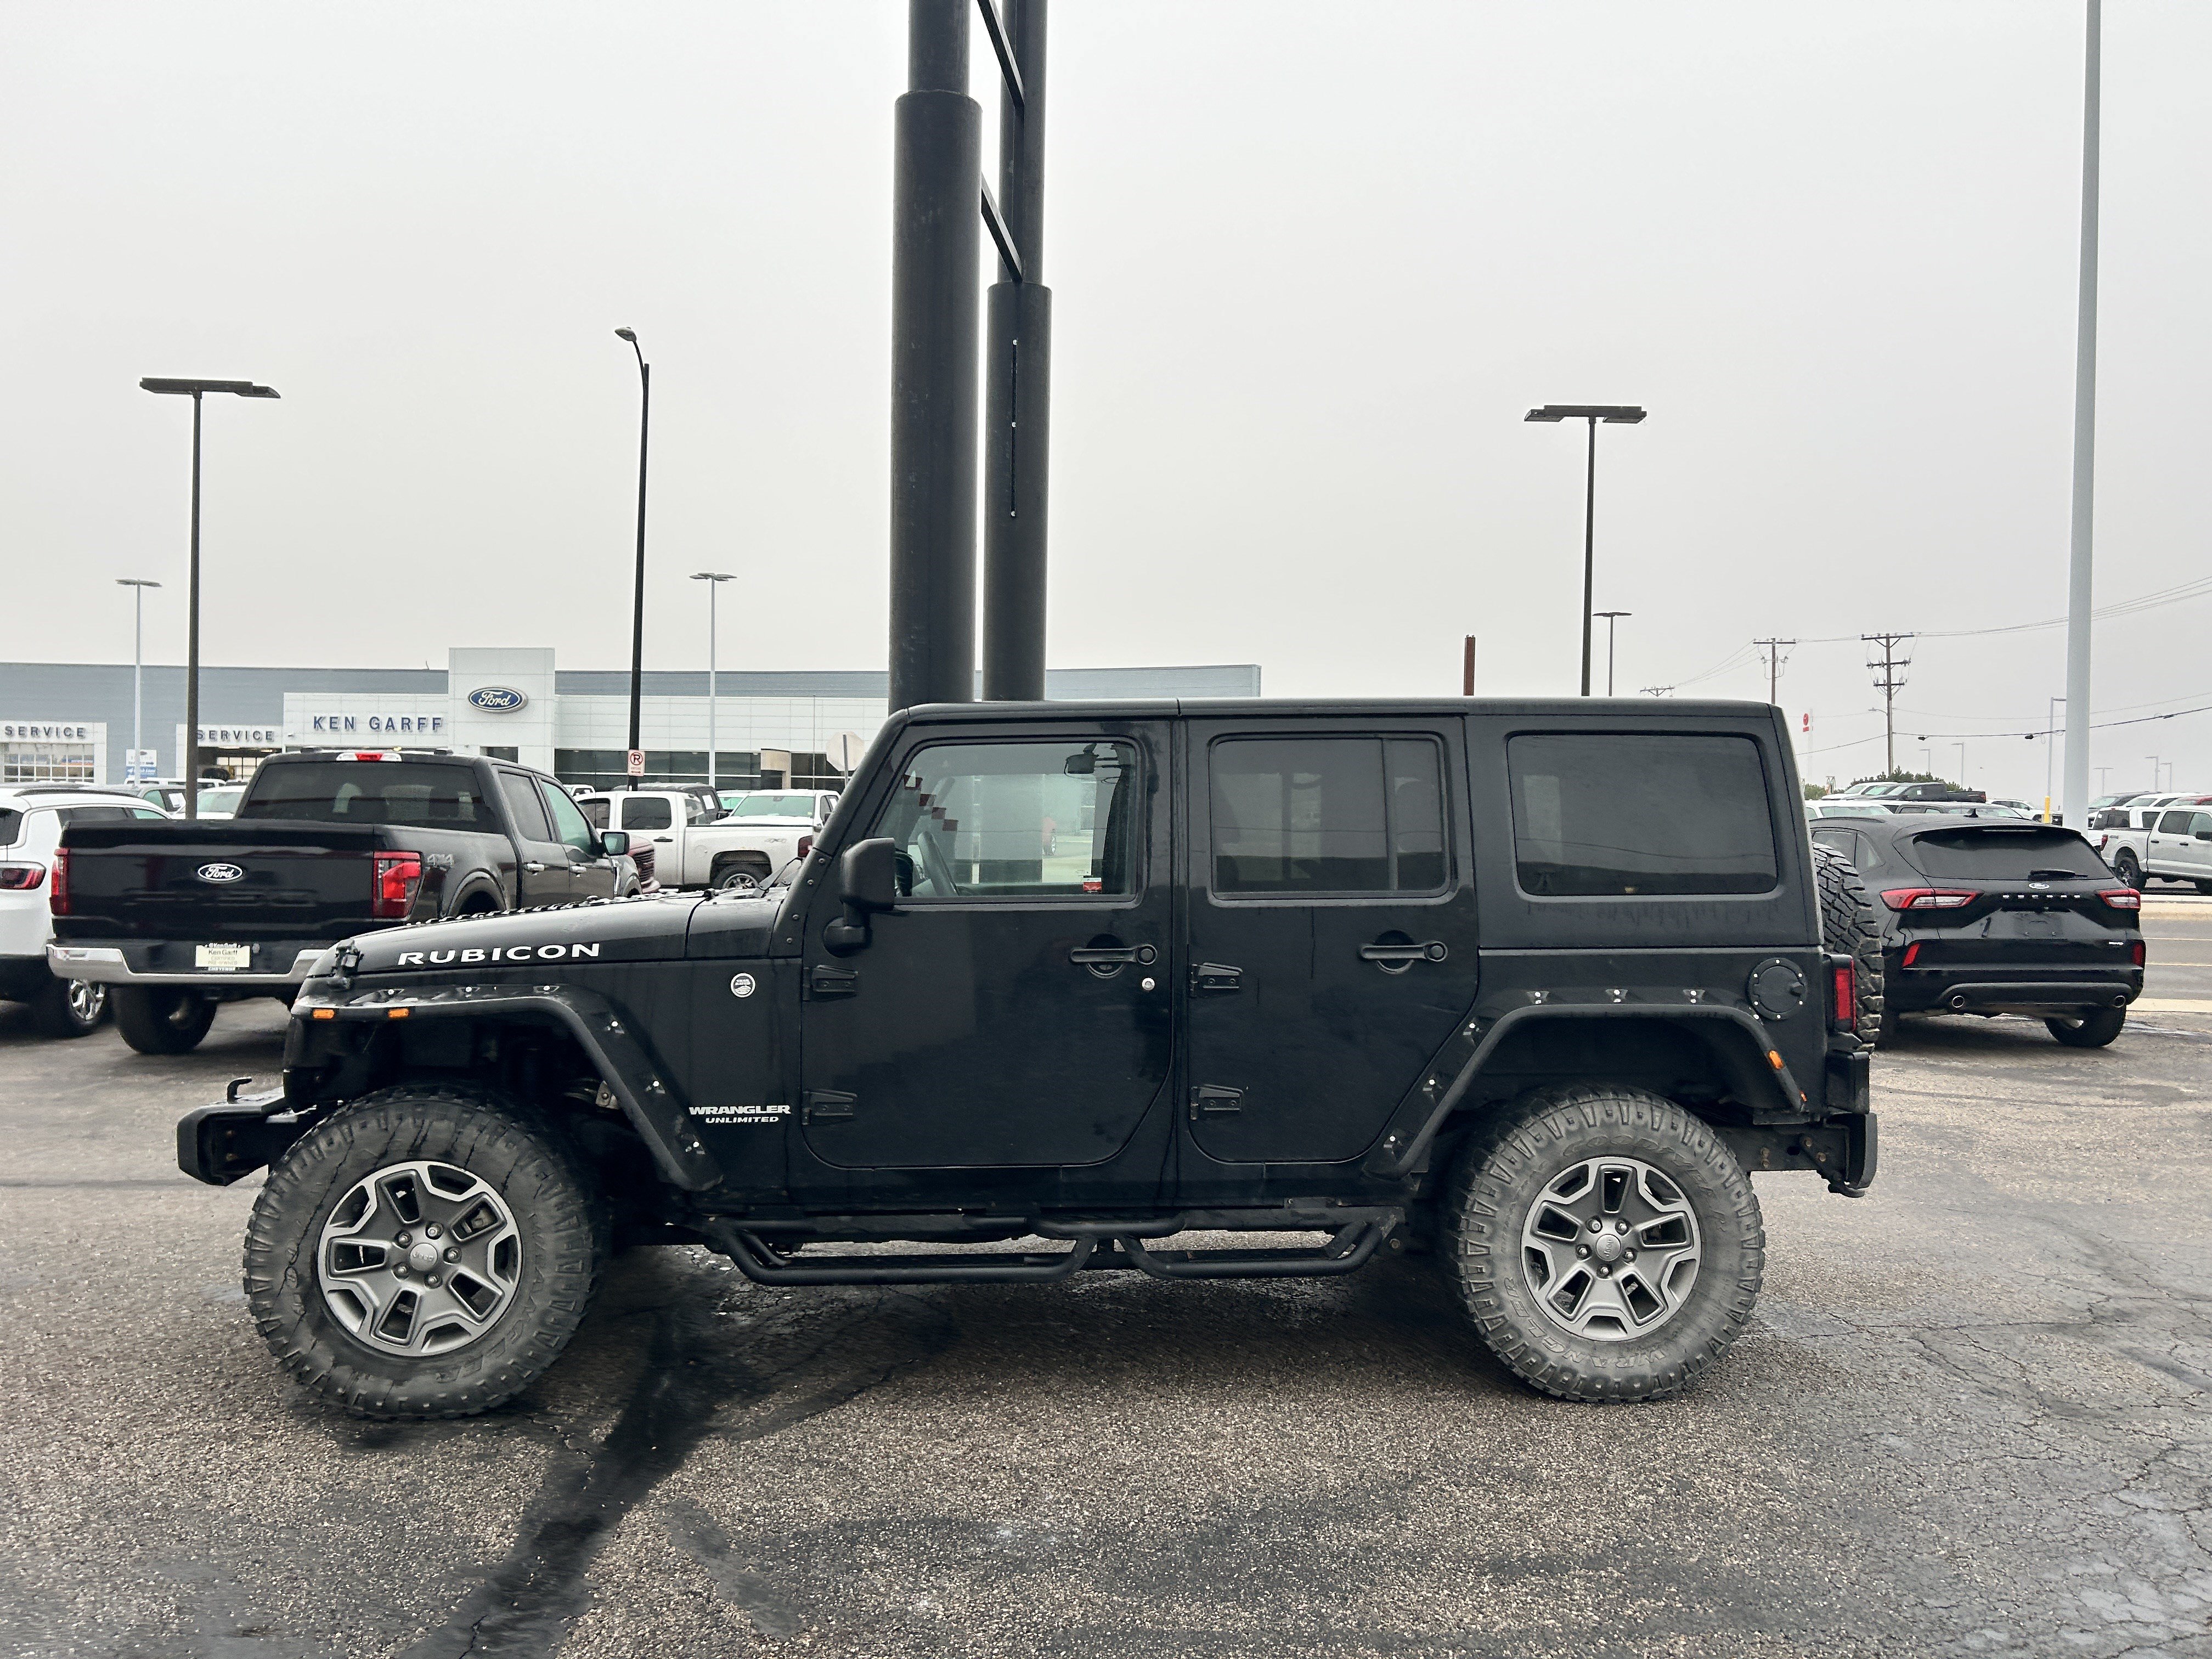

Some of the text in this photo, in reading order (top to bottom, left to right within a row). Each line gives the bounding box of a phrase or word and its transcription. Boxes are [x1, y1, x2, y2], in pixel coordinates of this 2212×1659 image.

[478, 691, 511, 706] Ford
[313, 716, 442, 731] KEN GARFF
[4, 725, 85, 737] SERVICE
[198, 730, 274, 741] SERVICE
[205, 866, 234, 878] Ford
[398, 943, 601, 966] RUBICON
[689, 1104, 792, 1115] WRANGLER
